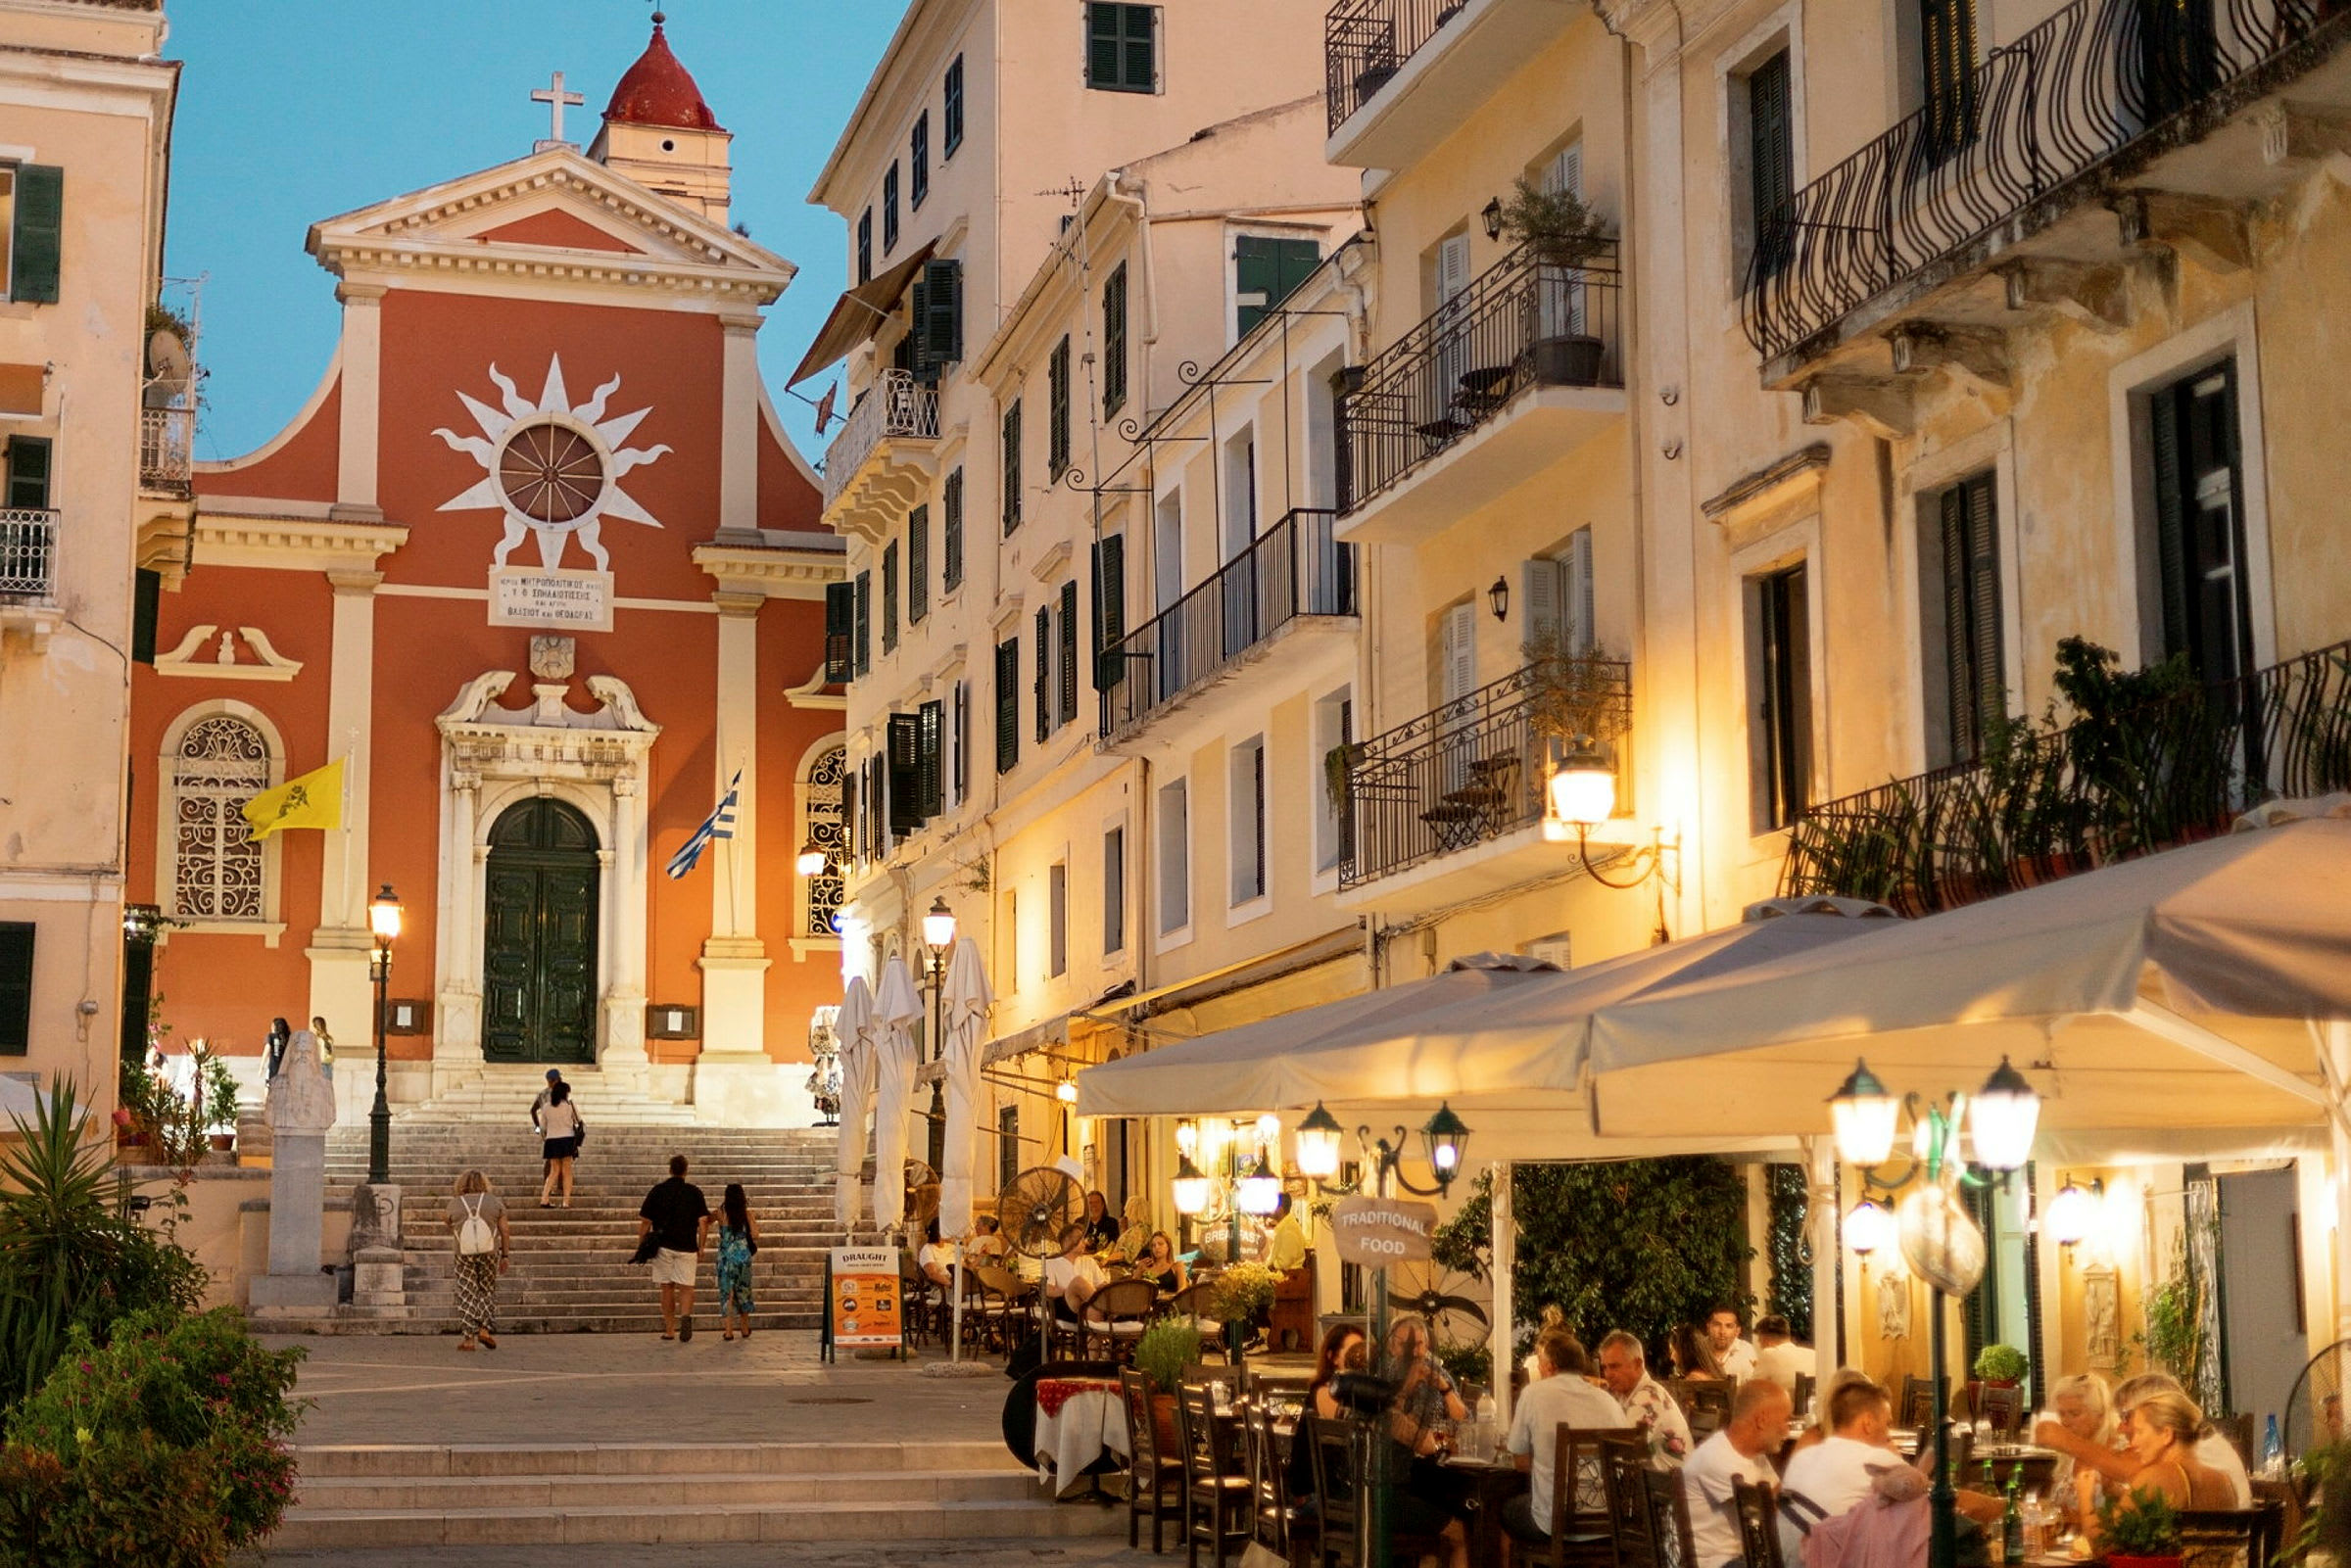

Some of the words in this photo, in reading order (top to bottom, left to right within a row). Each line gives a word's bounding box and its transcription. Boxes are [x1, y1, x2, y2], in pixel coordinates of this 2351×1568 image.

[1342, 1210, 1428, 1237] TRADITIONAL
[1360, 1237, 1406, 1255] FOOD
[842, 1253, 887, 1262] DRAUGHT
